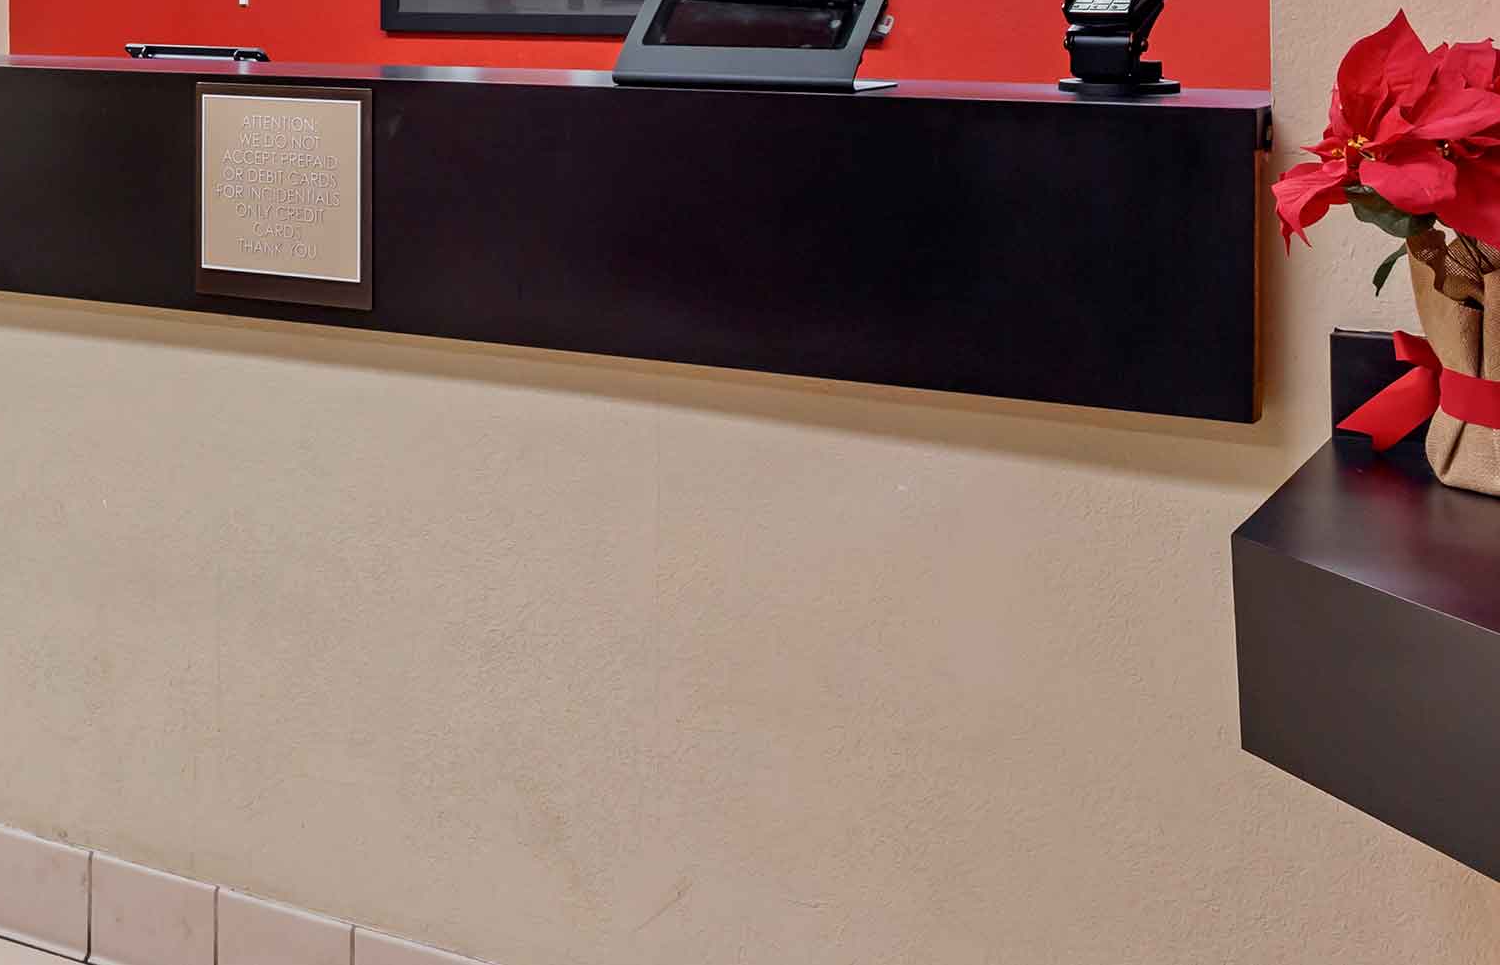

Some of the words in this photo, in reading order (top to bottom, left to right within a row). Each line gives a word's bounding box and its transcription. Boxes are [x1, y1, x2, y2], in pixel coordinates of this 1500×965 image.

[239, 132, 261, 148] WE
[263, 132, 287, 150] DO
[291, 135, 321, 151] NOT
[222, 149, 277, 166] ACCEPT
[280, 154, 339, 170] PREPAID
[222, 166, 244, 182] OR
[247, 168, 284, 186] DEBIT
[288, 172, 339, 189] CARDS
[215, 183, 244, 199] FOR
[236, 203, 273, 220] ONLY
[276, 206, 325, 223] CREDIT
[236, 237, 284, 254] THANK
[291, 243, 318, 260] YOU
